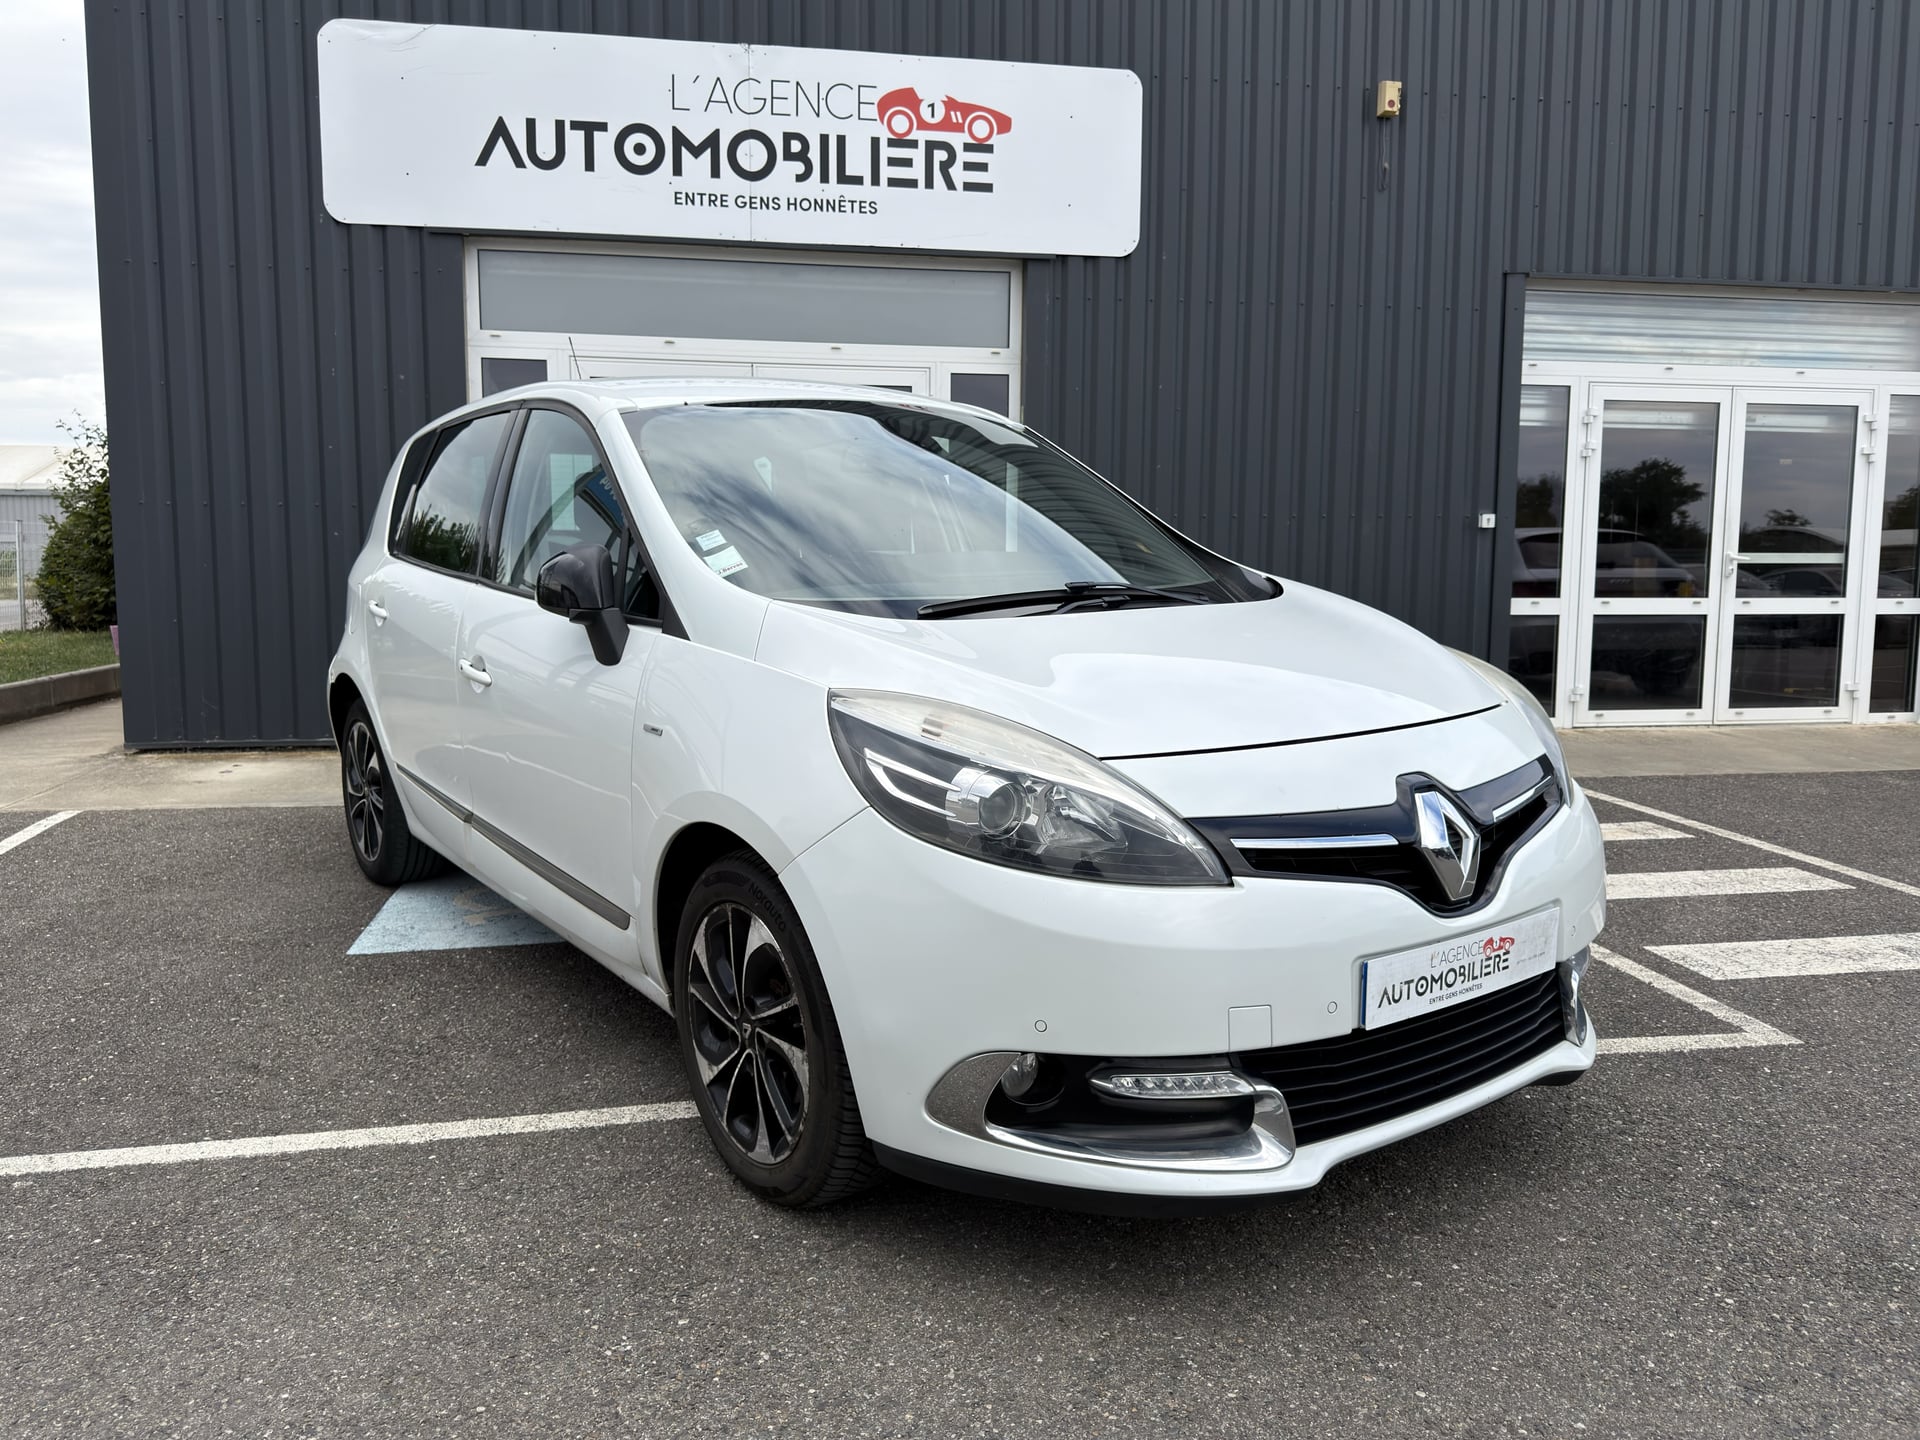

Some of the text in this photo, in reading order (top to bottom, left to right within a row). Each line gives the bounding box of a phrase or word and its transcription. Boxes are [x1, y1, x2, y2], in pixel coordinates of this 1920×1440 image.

[671, 73, 877, 121] L'AGENCE
[927, 102, 935, 118] 1
[674, 191, 878, 215] ENTRE GENS HONNÊTES
[748, 882, 786, 932] Norauto
[1428, 994, 1445, 1005] ENTRE
[1445, 990, 1459, 1000] GENS
